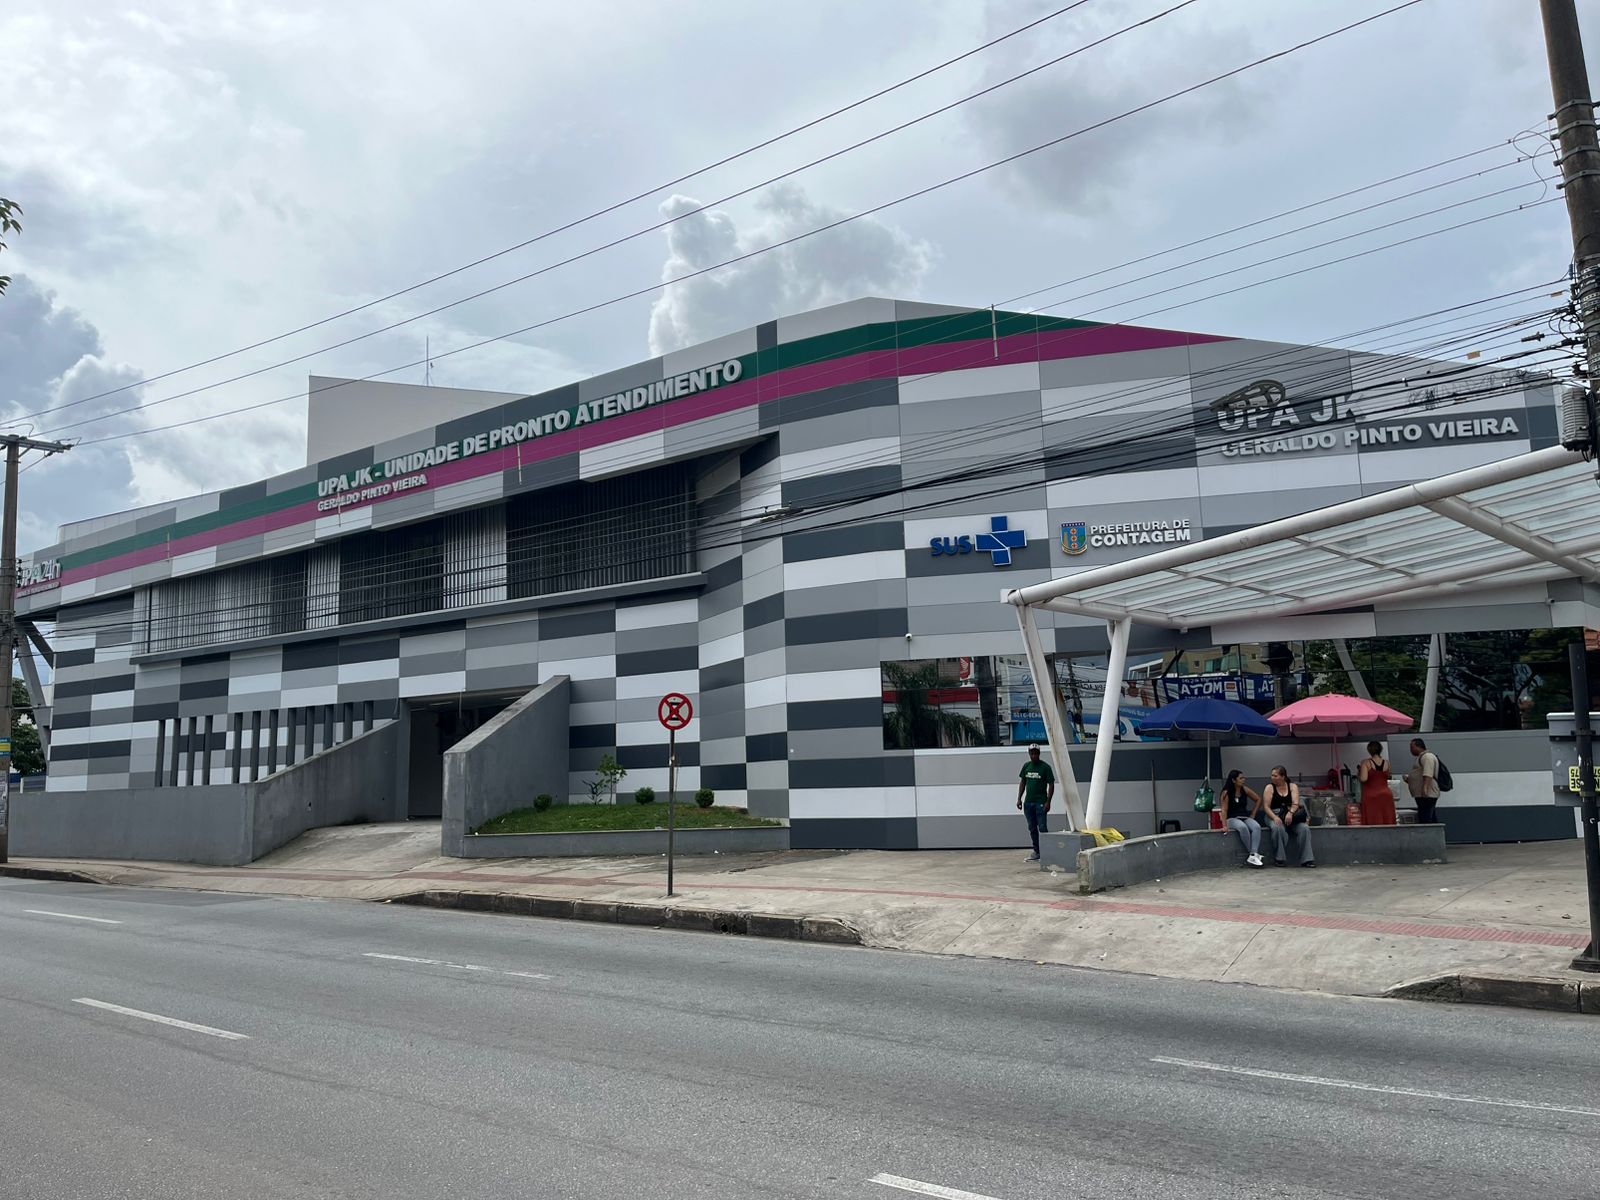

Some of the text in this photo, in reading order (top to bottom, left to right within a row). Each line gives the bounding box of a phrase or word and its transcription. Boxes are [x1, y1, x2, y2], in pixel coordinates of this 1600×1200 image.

[318, 473, 349, 497] UPA
[351, 466, 373, 488] JK
[384, 442, 459, 478] UNIDADE
[463, 434, 488, 456] DE
[489, 408, 571, 449] PRONTO
[575, 358, 743, 426] ATENDIMENTO
[1217, 399, 1300, 432] UPA
[1221, 416, 1519, 457] GERALDO PINTO VIEIRA
[317, 473, 428, 512] GERALDO PINTO VIEIRA
[1090, 518, 1190, 534] PREFEITURA DE
[1090, 528, 1191, 547] CONTAGEM
[930, 534, 973, 557] SUS
